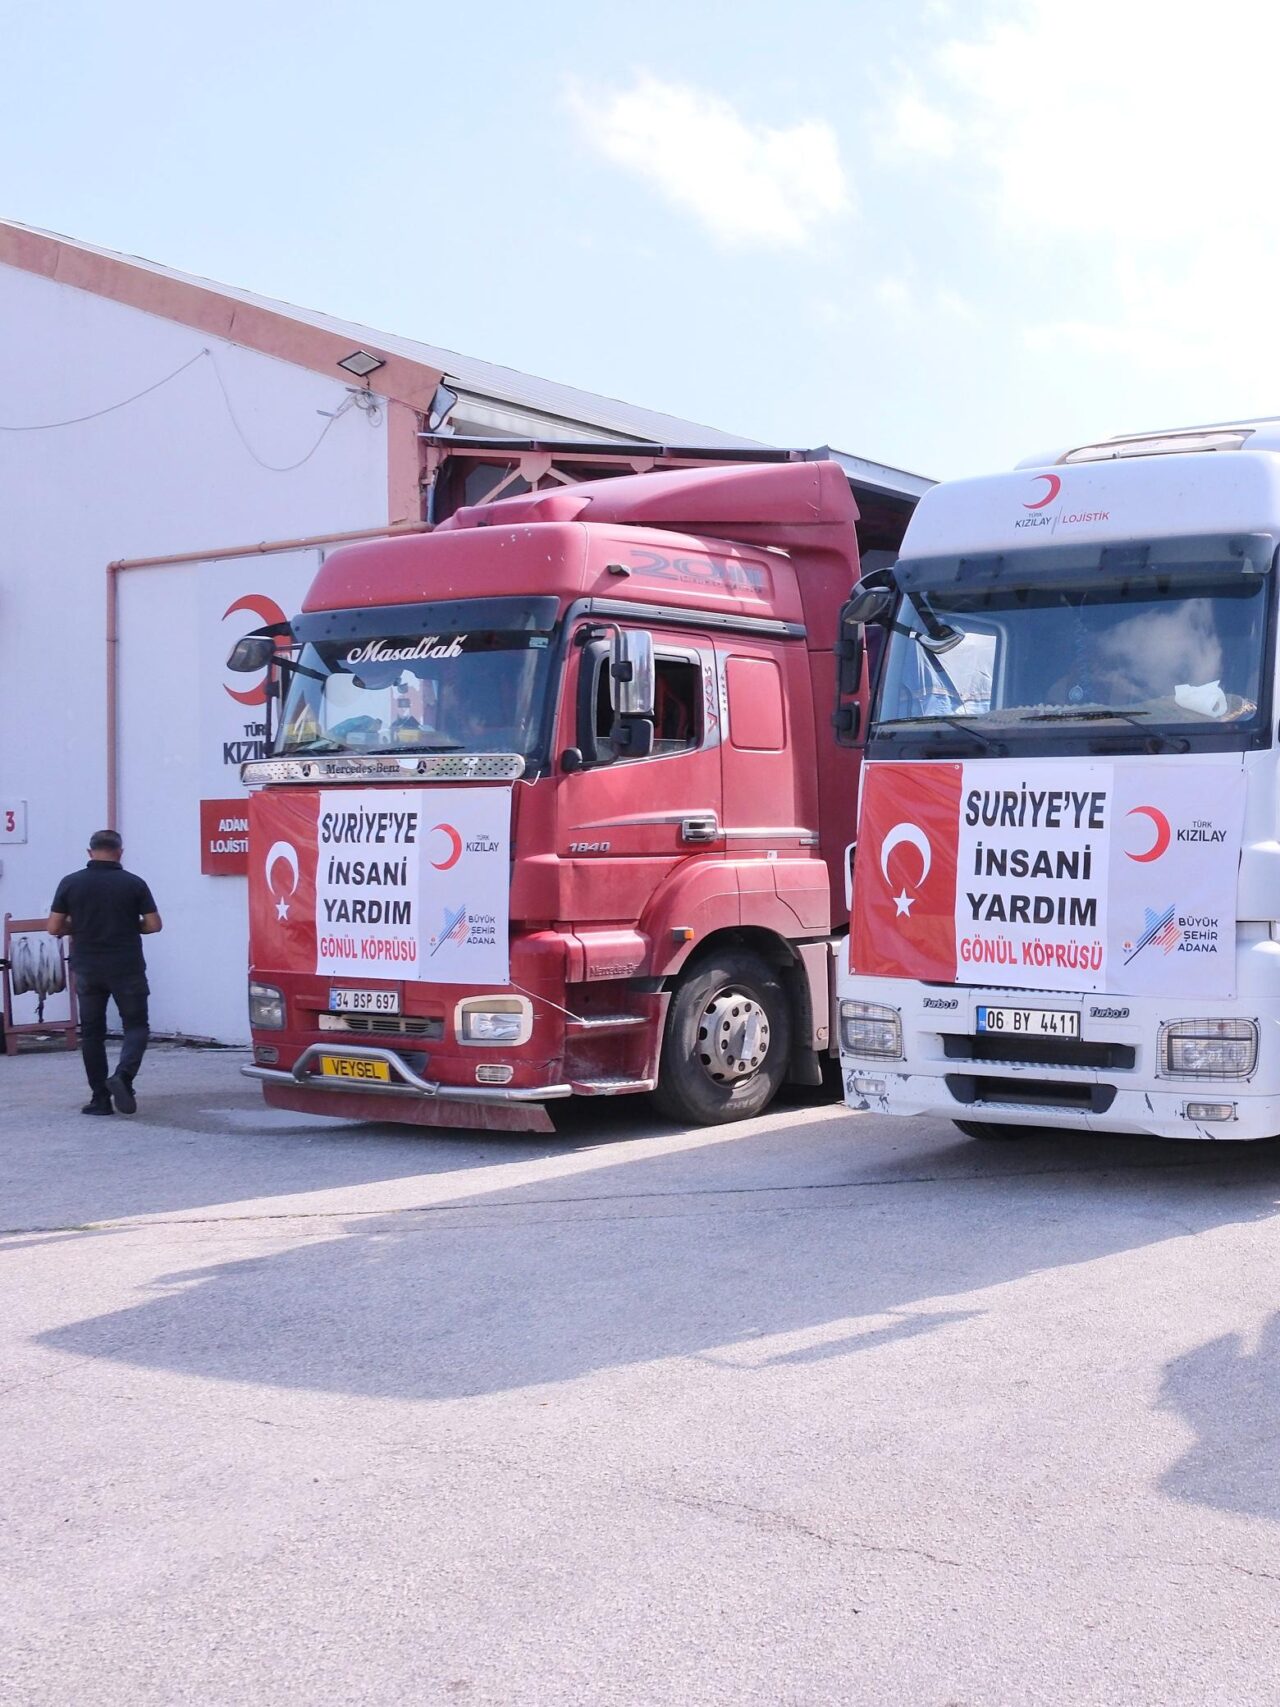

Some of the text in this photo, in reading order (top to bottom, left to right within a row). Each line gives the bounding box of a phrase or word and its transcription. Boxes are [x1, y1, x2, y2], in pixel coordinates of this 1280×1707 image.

[1015, 511, 1110, 528] KIZILAY LOJİSTİK
[243, 722, 266, 737] TÜR
[223, 741, 269, 765] KIZIL
[326, 759, 400, 774] Mercedes-Benz
[965, 782, 1106, 829] SURİYE'YE
[6, 811, 15, 832] 3
[218, 817, 249, 831] ADAN
[322, 805, 418, 844] SURİYE'YE
[1192, 820, 1212, 828] TÜRK
[1177, 829, 1227, 842] KIZILAY
[210, 837, 249, 853] LOJİSTİ
[466, 842, 499, 852] KIZILAY
[569, 841, 610, 853] 1840
[974, 841, 1091, 880] İNSANİ
[328, 856, 407, 886] İNSANİ
[323, 899, 411, 925] YARDIM
[966, 892, 1097, 926] YARDIM
[1178, 915, 1219, 927] BÜYÜK
[466, 936, 496, 945] ADANA
[1183, 930, 1218, 942] ŞEHİR
[320, 934, 416, 961] GÖNÜL KÖPRÜSÜ
[960, 934, 1103, 971] GÖNÜL KÖPRÜSÜ
[1177, 943, 1218, 953] ADANA
[336, 992, 396, 1010] 34 BSP 697
[986, 1010, 1075, 1034] 06 BY 4411
[331, 1060, 382, 1080] VEYSEL
